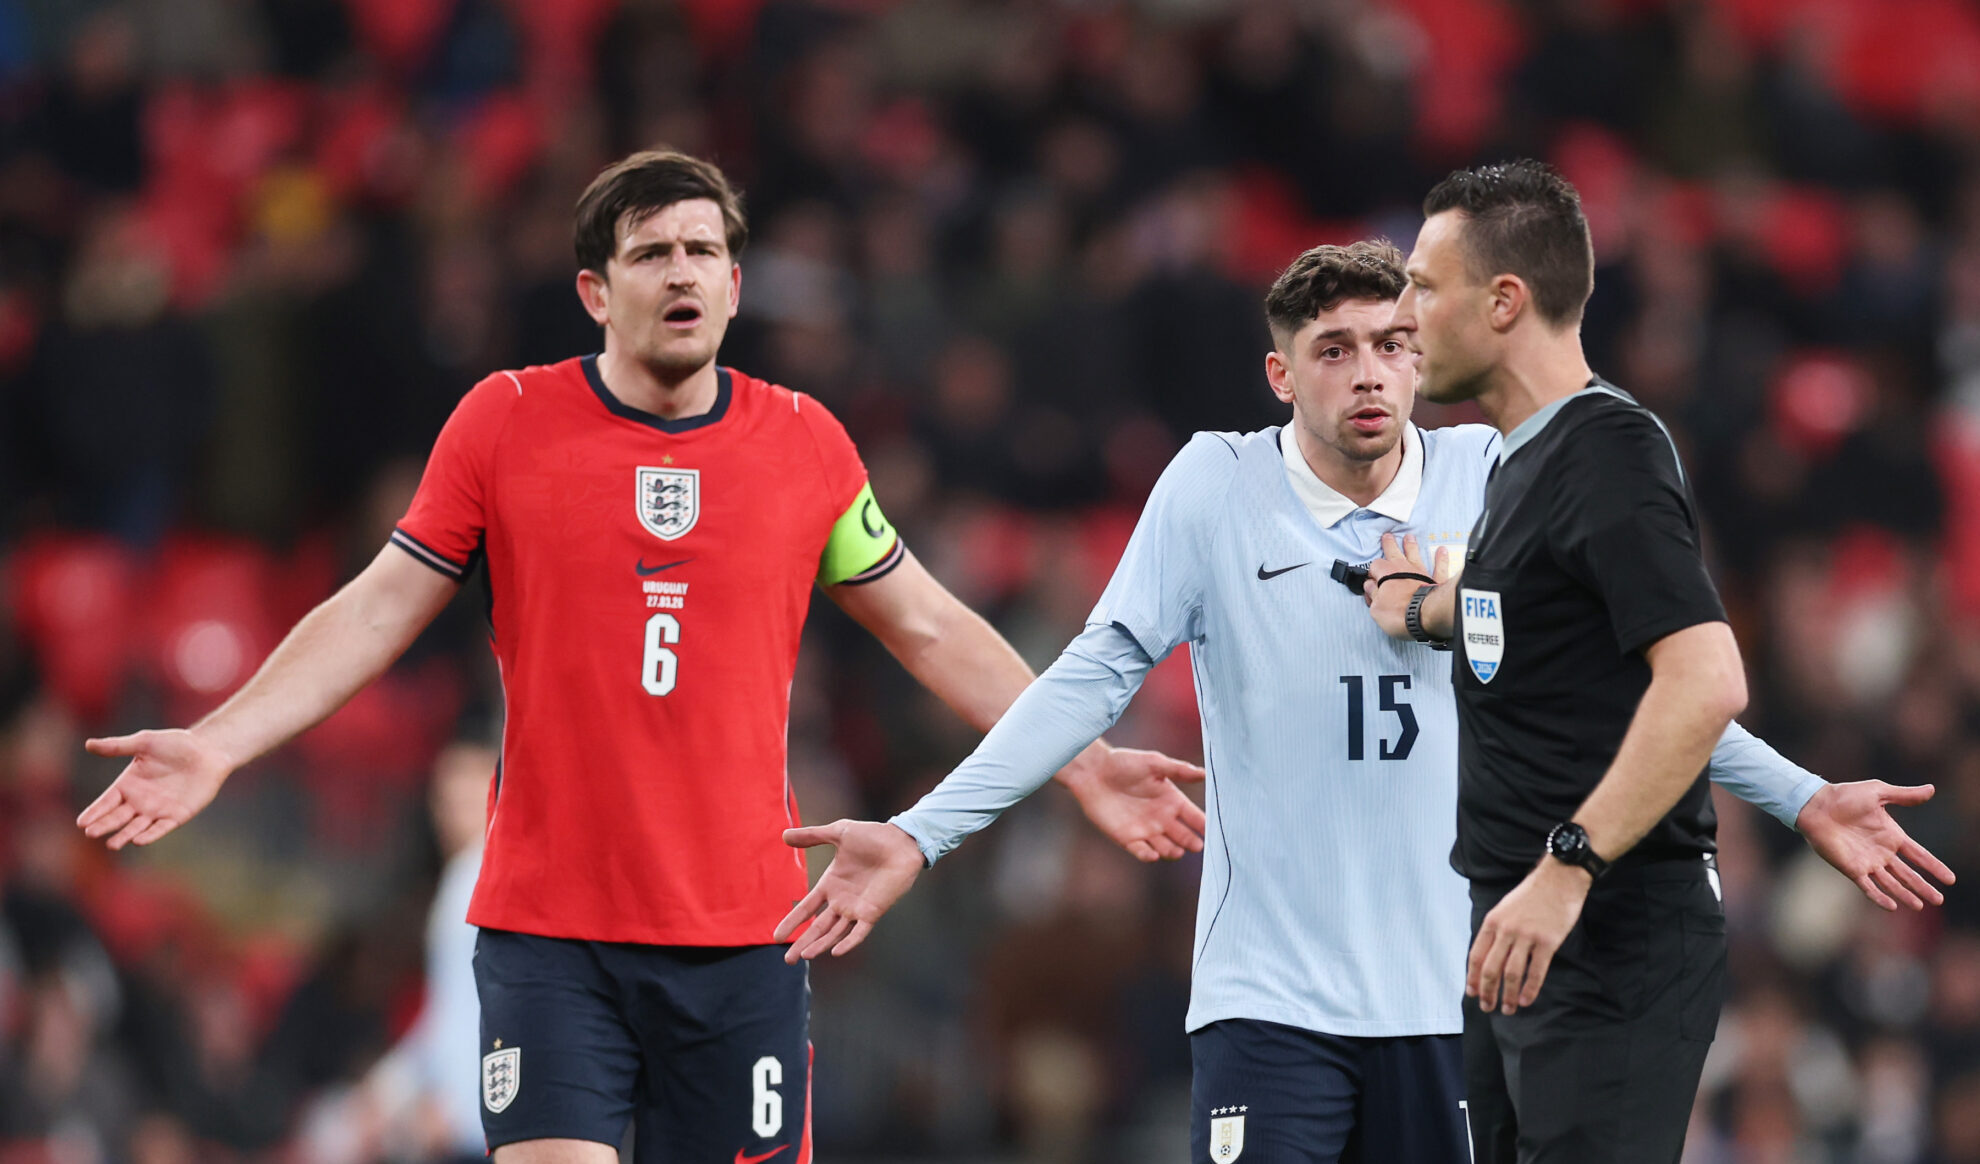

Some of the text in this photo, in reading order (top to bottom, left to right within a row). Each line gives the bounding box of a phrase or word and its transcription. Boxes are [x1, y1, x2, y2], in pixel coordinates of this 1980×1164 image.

[642, 580, 689, 595] URUGUAY
[1466, 597, 1498, 619] FIFA
[641, 612, 681, 697] 6
[1467, 632, 1500, 646] REFEREE
[1339, 674, 1420, 760] 15
[752, 1056, 783, 1138] 6
